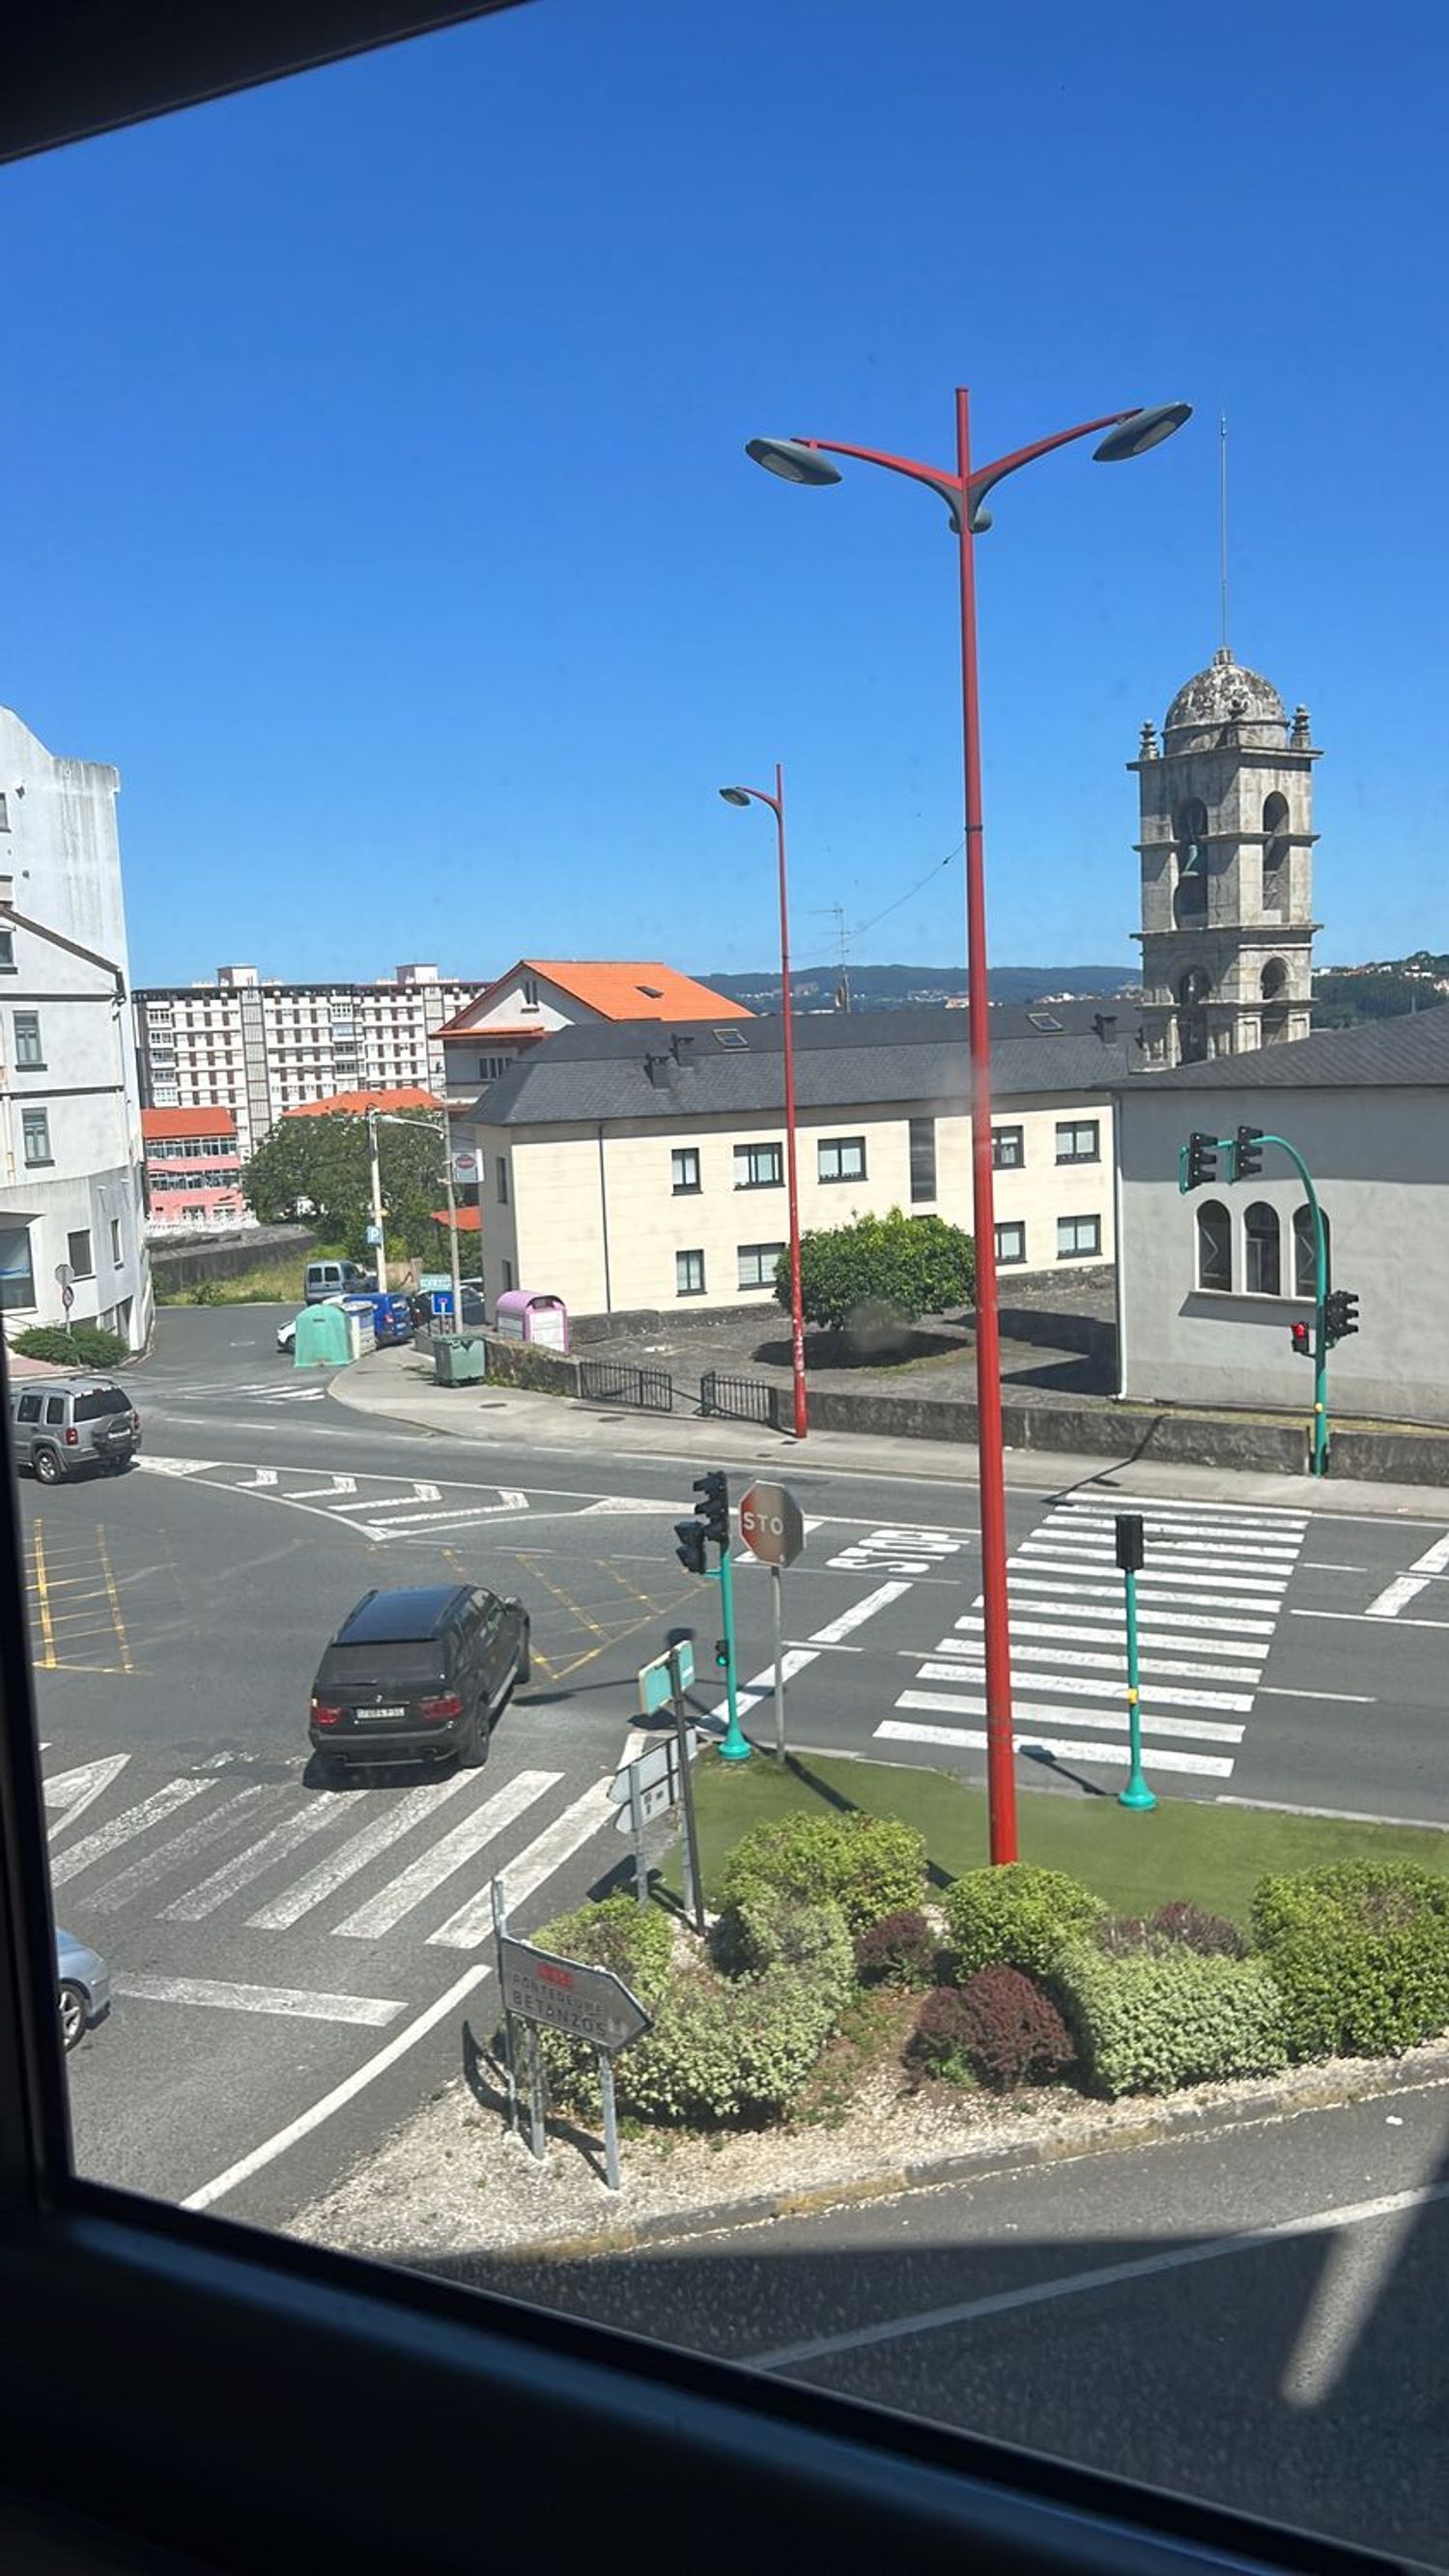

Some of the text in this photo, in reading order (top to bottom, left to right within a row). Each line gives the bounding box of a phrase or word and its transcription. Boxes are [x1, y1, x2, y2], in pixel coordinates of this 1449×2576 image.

[743, 1511, 785, 1536] STO
[825, 1529, 970, 1574] STOP
[512, 1989, 608, 2037] BETANZOS
